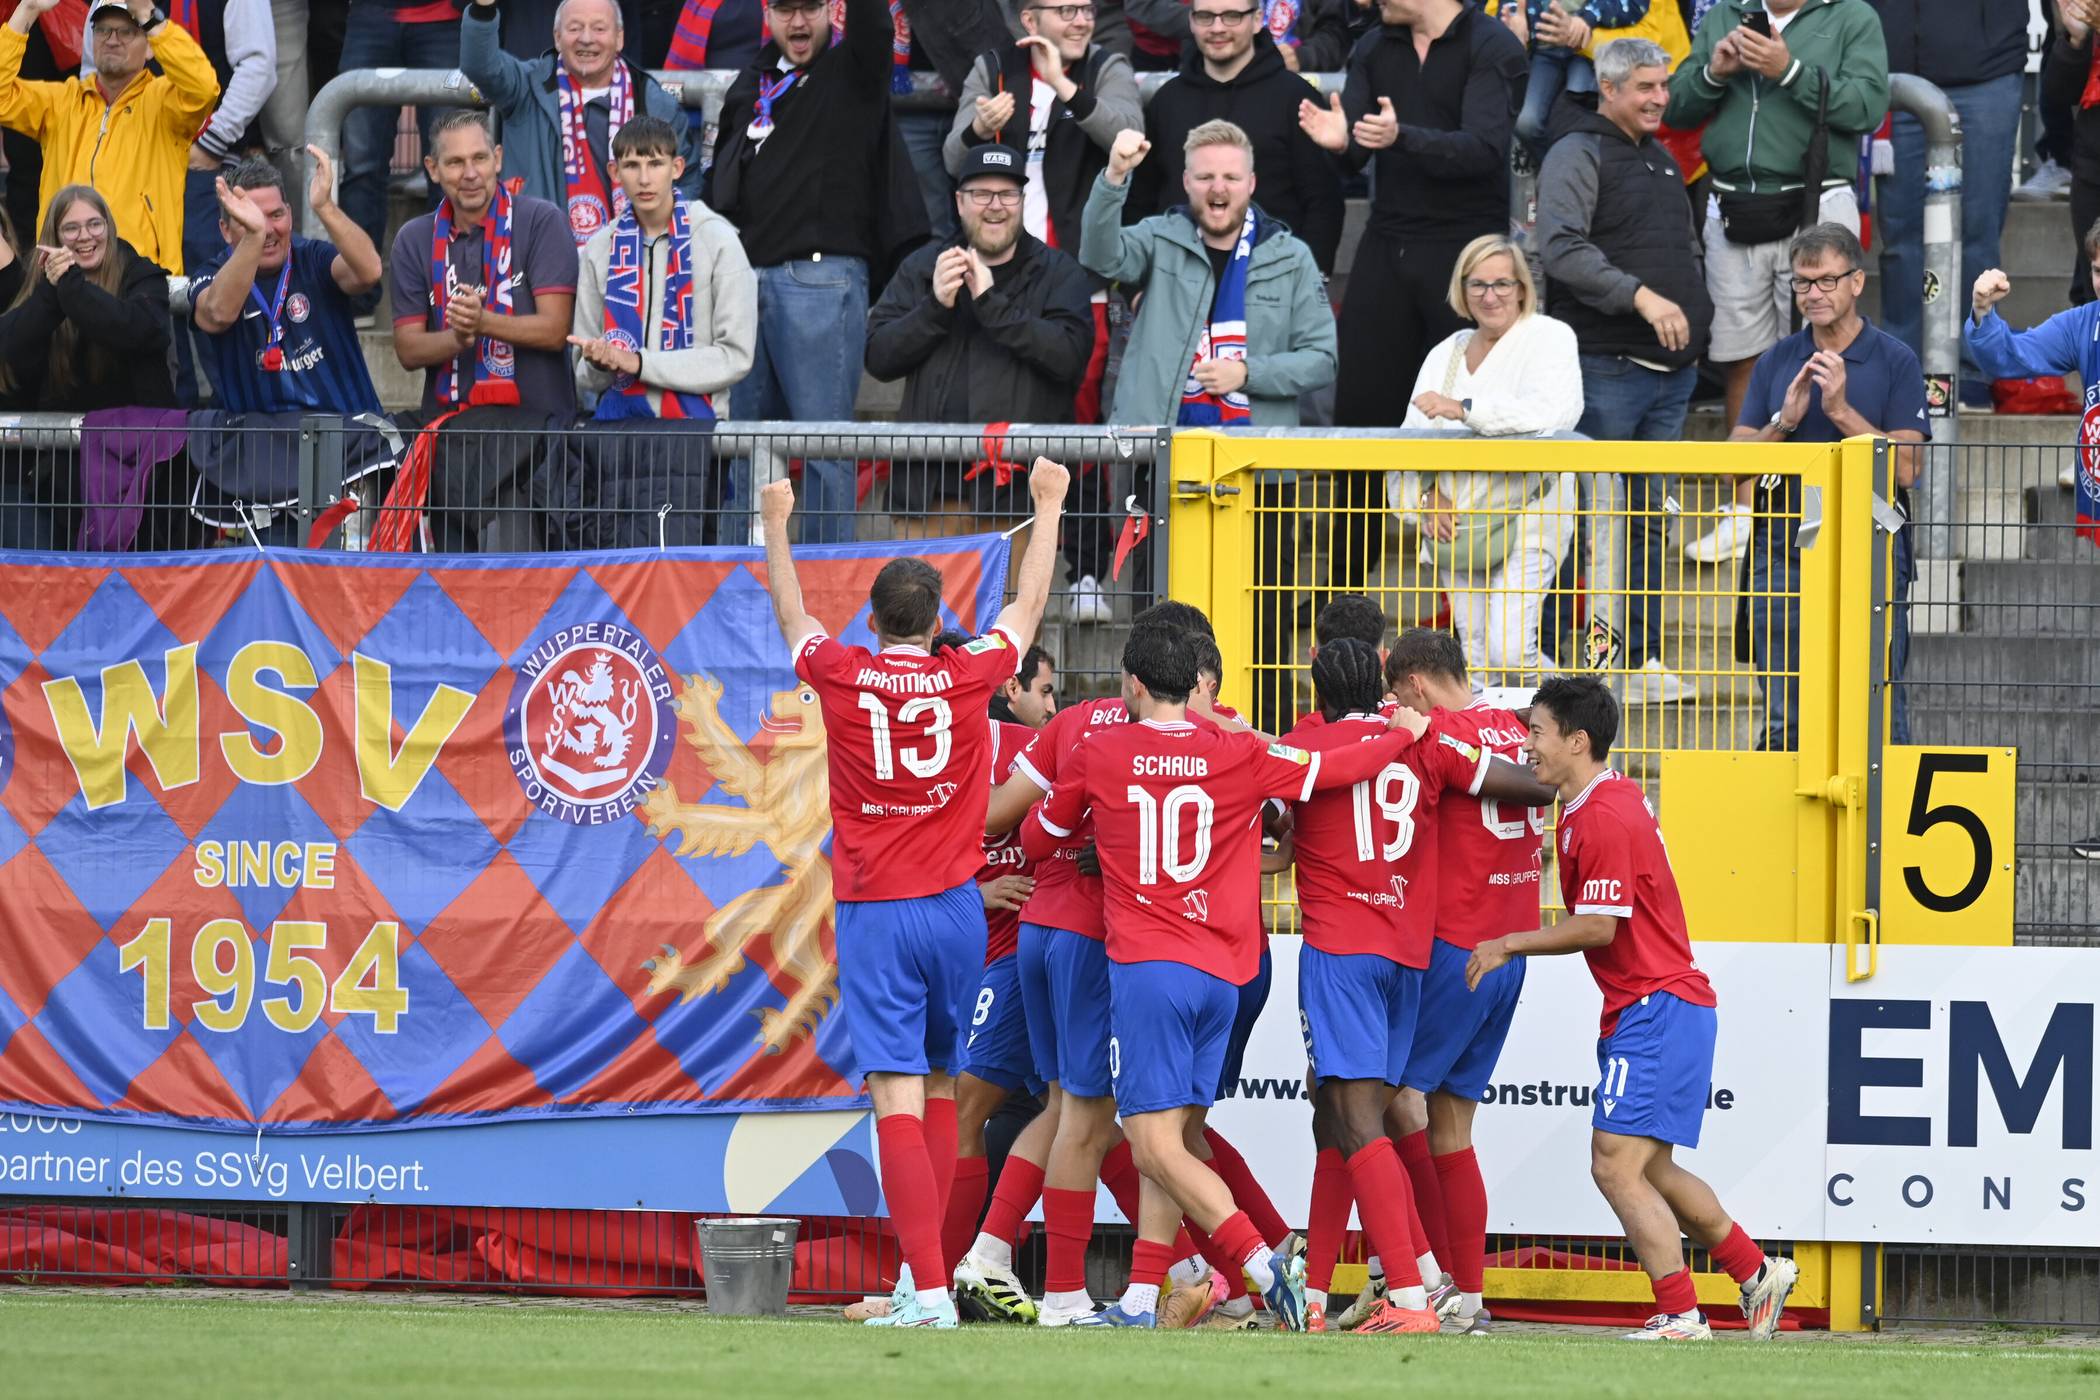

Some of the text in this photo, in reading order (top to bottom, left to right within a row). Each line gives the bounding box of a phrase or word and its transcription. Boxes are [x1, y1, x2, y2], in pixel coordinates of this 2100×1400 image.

[520, 622, 673, 703] WUPPERTALER
[856, 667, 953, 694] HARTMANN
[40, 640, 478, 813] WSV
[858, 691, 953, 781] 13
[509, 748, 658, 826] SPORTVEREIN
[1133, 755, 1208, 777] SCHAUB
[862, 802, 884, 815] MSS
[1902, 752, 1993, 913] 5
[1127, 784, 1215, 885] 10
[193, 839, 337, 889] SINCE
[1583, 878, 1622, 901] MTC
[119, 917, 409, 1034] 1954
[1479, 1080, 1602, 1107] onstru
[1605, 1057, 1630, 1098] 11
[1826, 998, 2095, 1151] EM
[120, 1149, 183, 1186] des
[193, 1150, 289, 1197] SSVg
[300, 1152, 431, 1192] Velbert.
[1826, 1172, 2087, 1213] CONS
